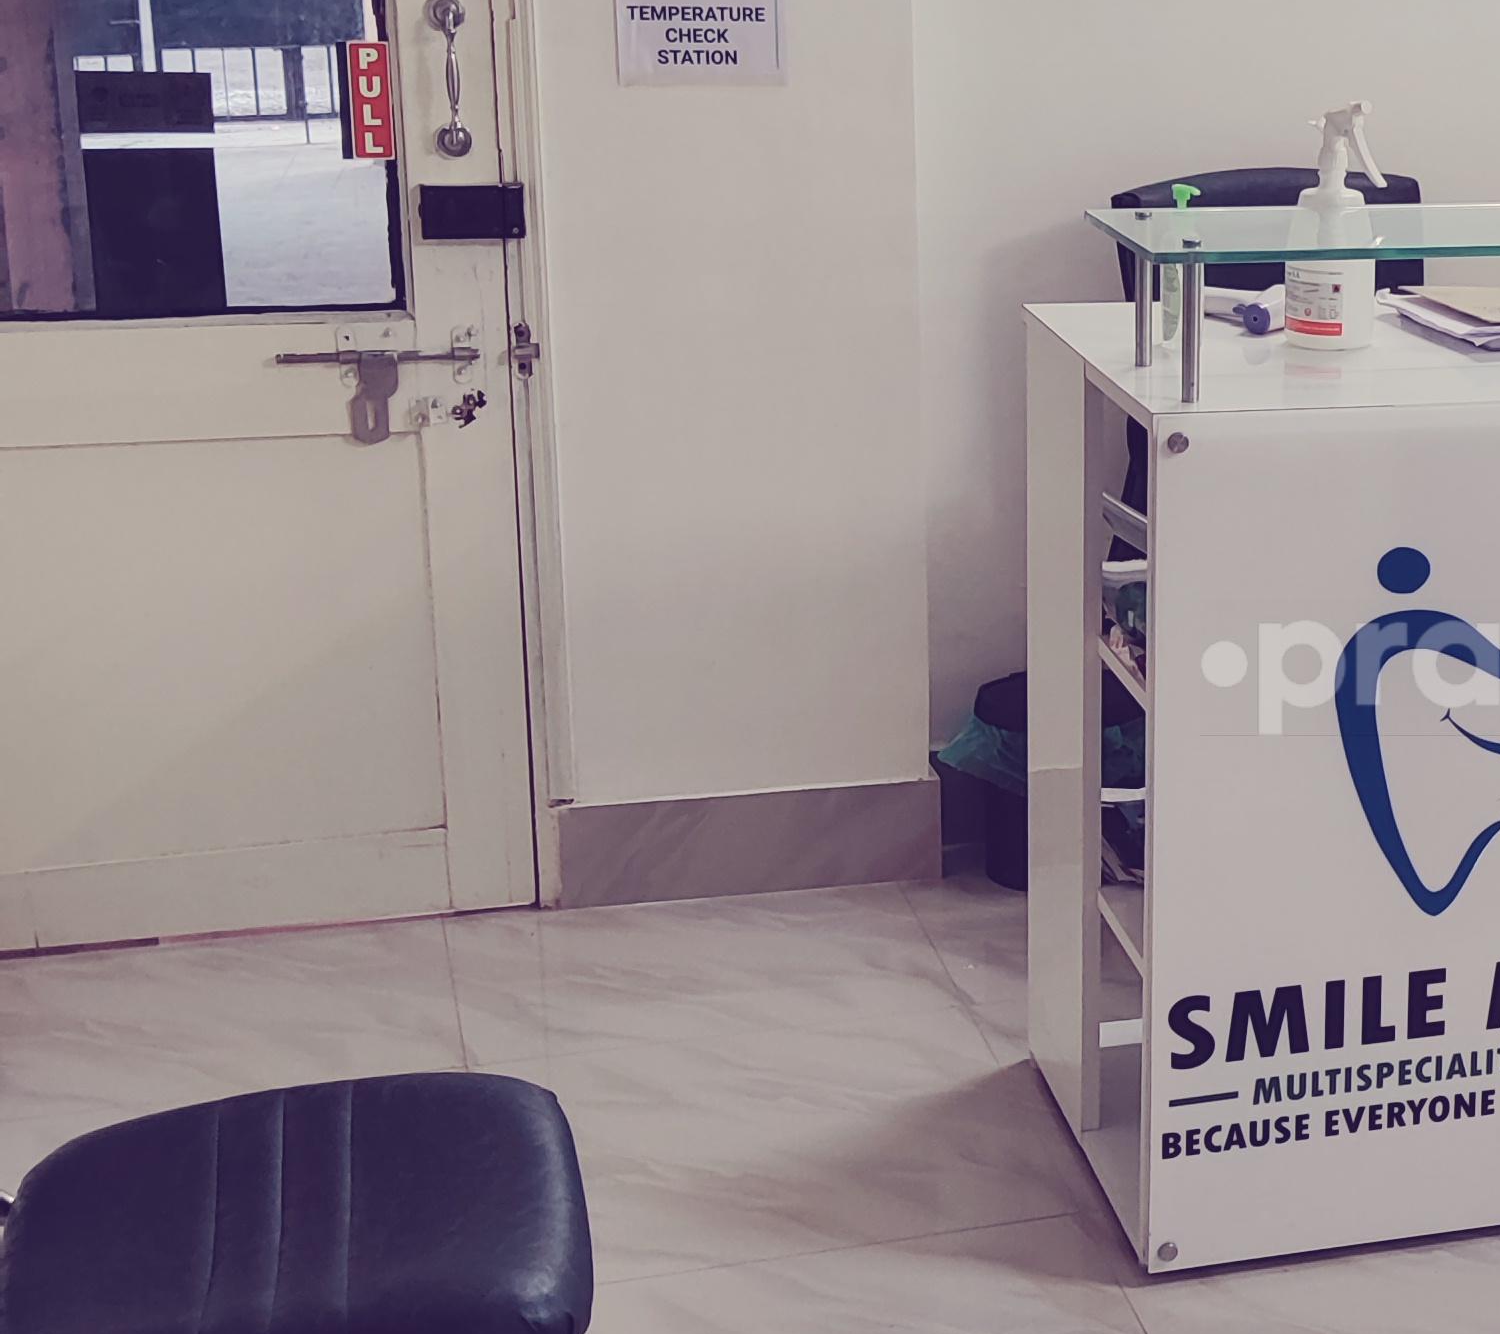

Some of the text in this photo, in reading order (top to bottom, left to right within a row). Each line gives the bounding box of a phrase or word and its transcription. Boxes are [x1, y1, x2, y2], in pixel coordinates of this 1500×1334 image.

[626, 5, 766, 22] TEMPERATURE
[665, 27, 730, 44] CHECK
[657, 49, 738, 65] STATION
[358, 47, 384, 154] PULL
[1167, 967, 1447, 1070] SMILE
[1161, 1113, 1311, 1160] BECAUSE
[1324, 1089, 1496, 1137] EVERYONE
